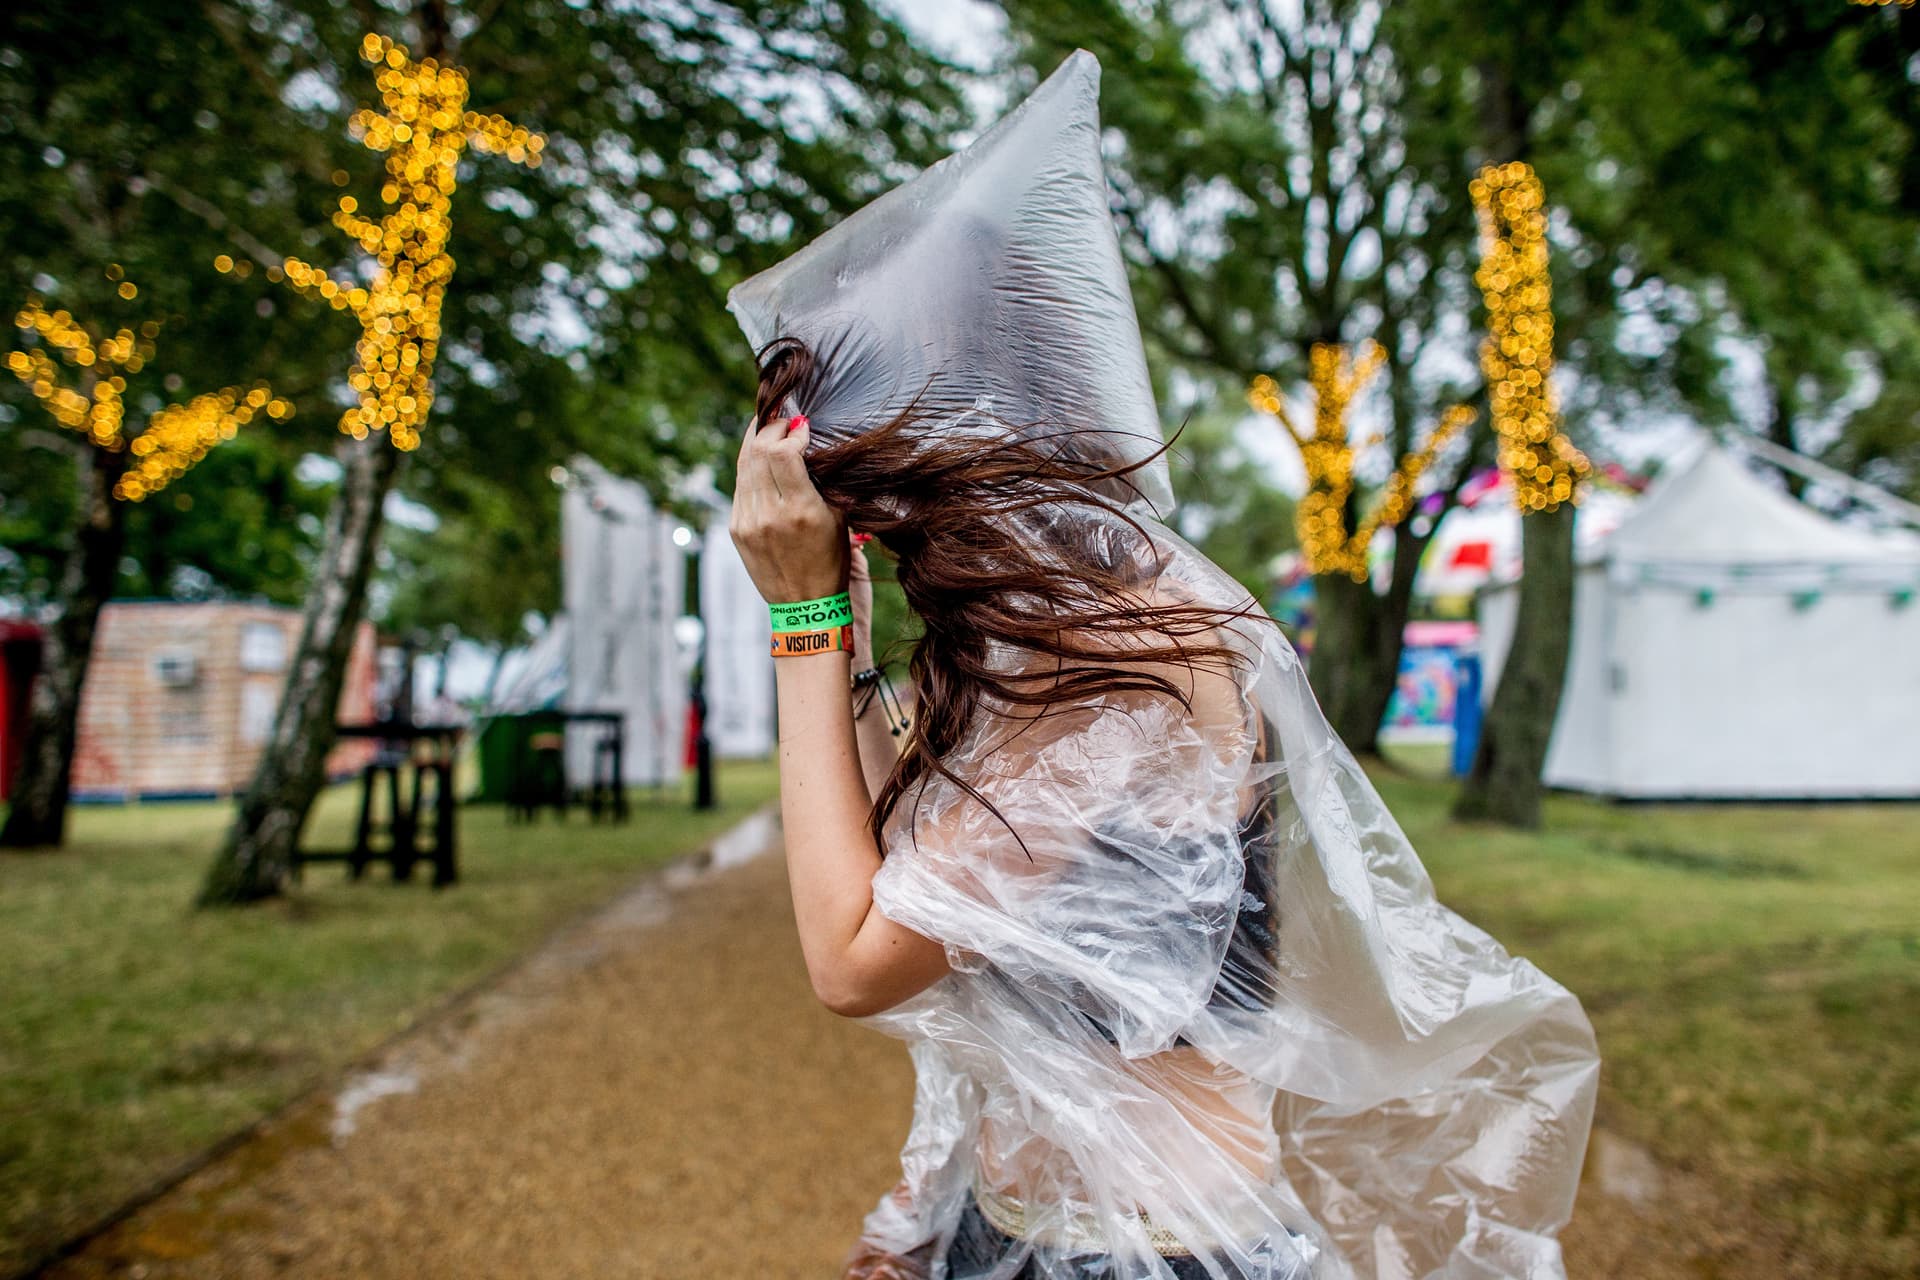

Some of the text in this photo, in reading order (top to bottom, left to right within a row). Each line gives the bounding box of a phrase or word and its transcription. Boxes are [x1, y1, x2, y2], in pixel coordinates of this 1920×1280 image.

[771, 604, 820, 614] CAMPING
[823, 600, 833, 608] &
[786, 633, 829, 652] VISITOR
